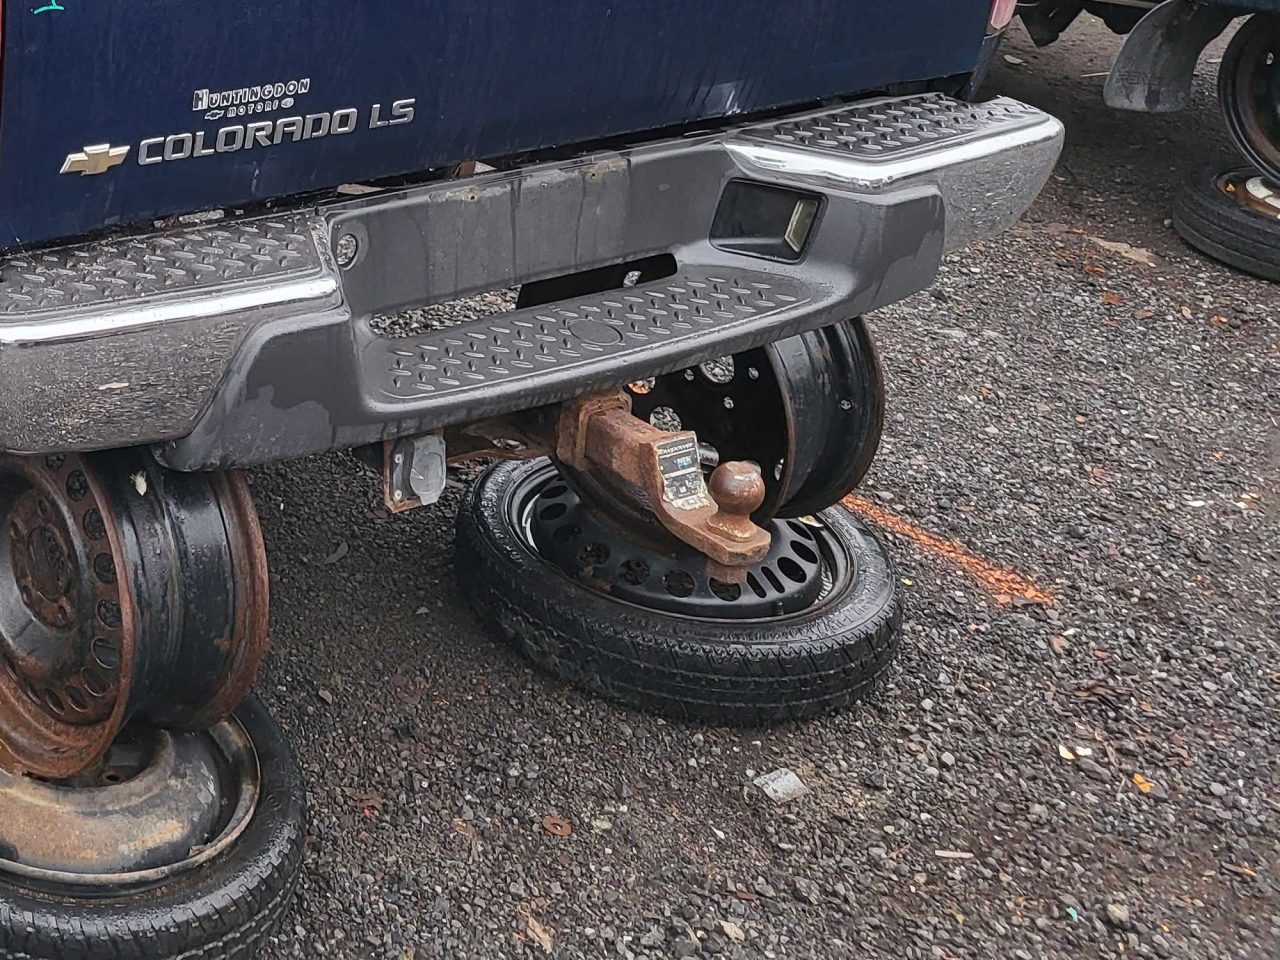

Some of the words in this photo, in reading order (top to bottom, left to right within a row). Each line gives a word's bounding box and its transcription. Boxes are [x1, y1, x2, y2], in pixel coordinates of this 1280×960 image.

[192, 78, 310, 111] HUNTINGDON
[226, 100, 279, 117] MOTORS
[138, 107, 358, 166] COLORADO
[369, 98, 416, 129] LS
